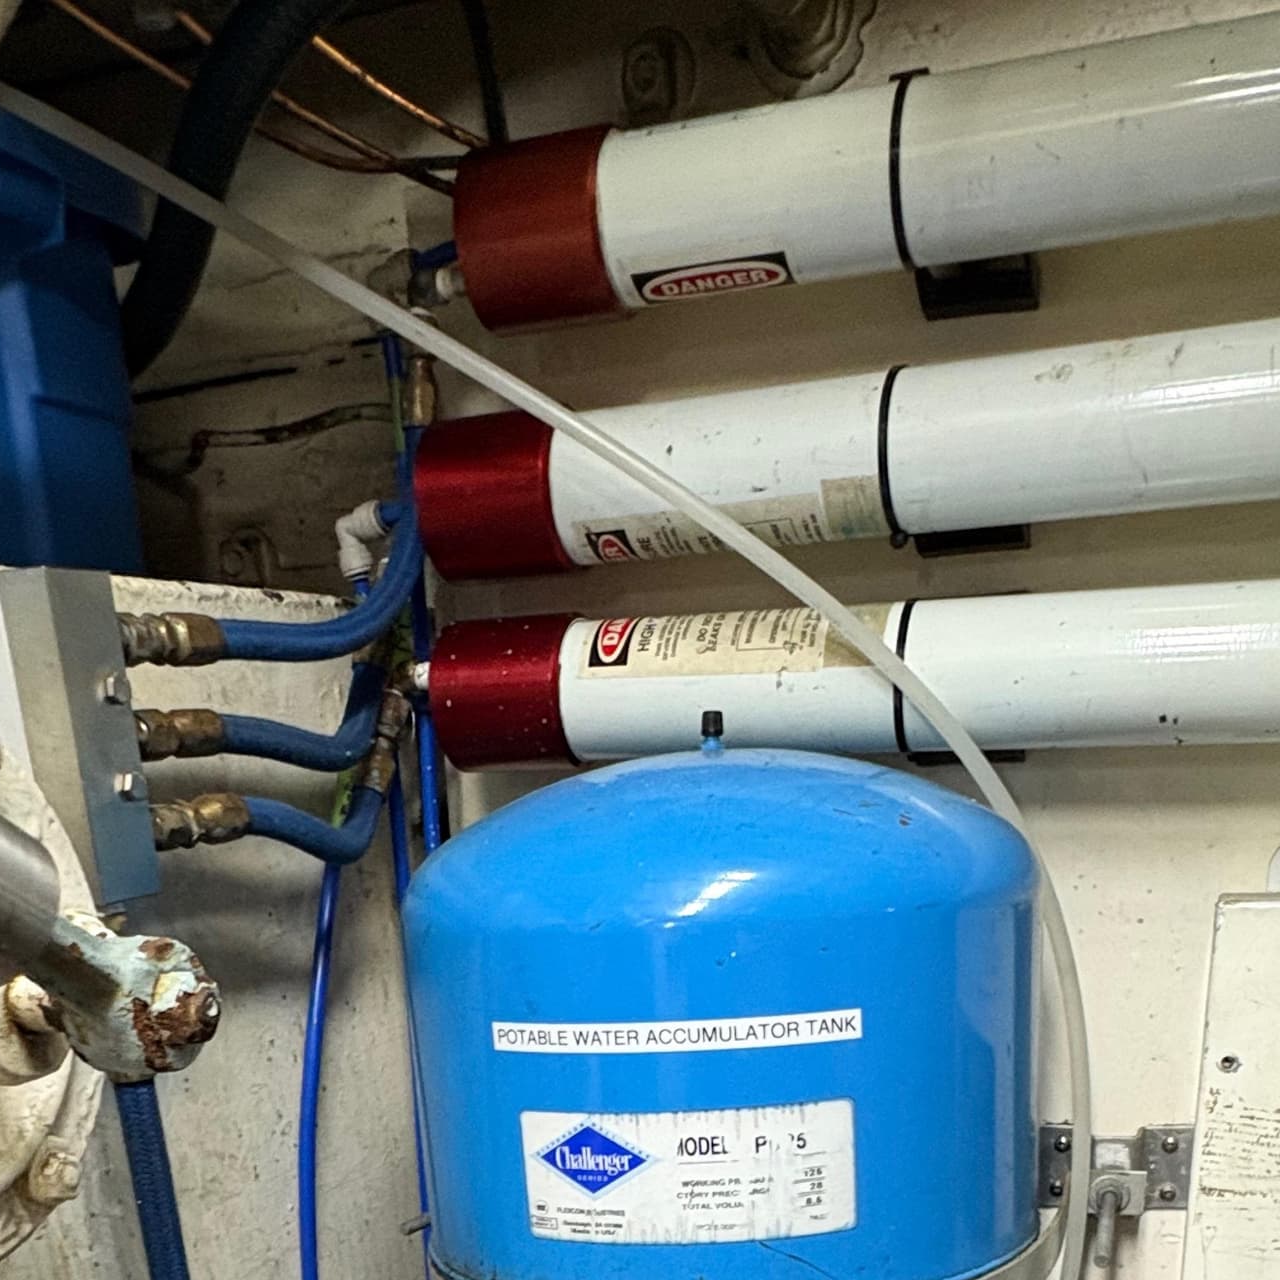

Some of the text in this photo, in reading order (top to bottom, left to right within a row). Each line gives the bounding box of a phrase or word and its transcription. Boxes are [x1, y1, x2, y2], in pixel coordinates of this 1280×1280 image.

[661, 269, 769, 296] DANGER
[636, 623, 656, 653] HIGH
[497, 1015, 857, 1046] POTABLE WATER ACCUMULATOR TANK
[555, 1145, 632, 1176] Challenger
